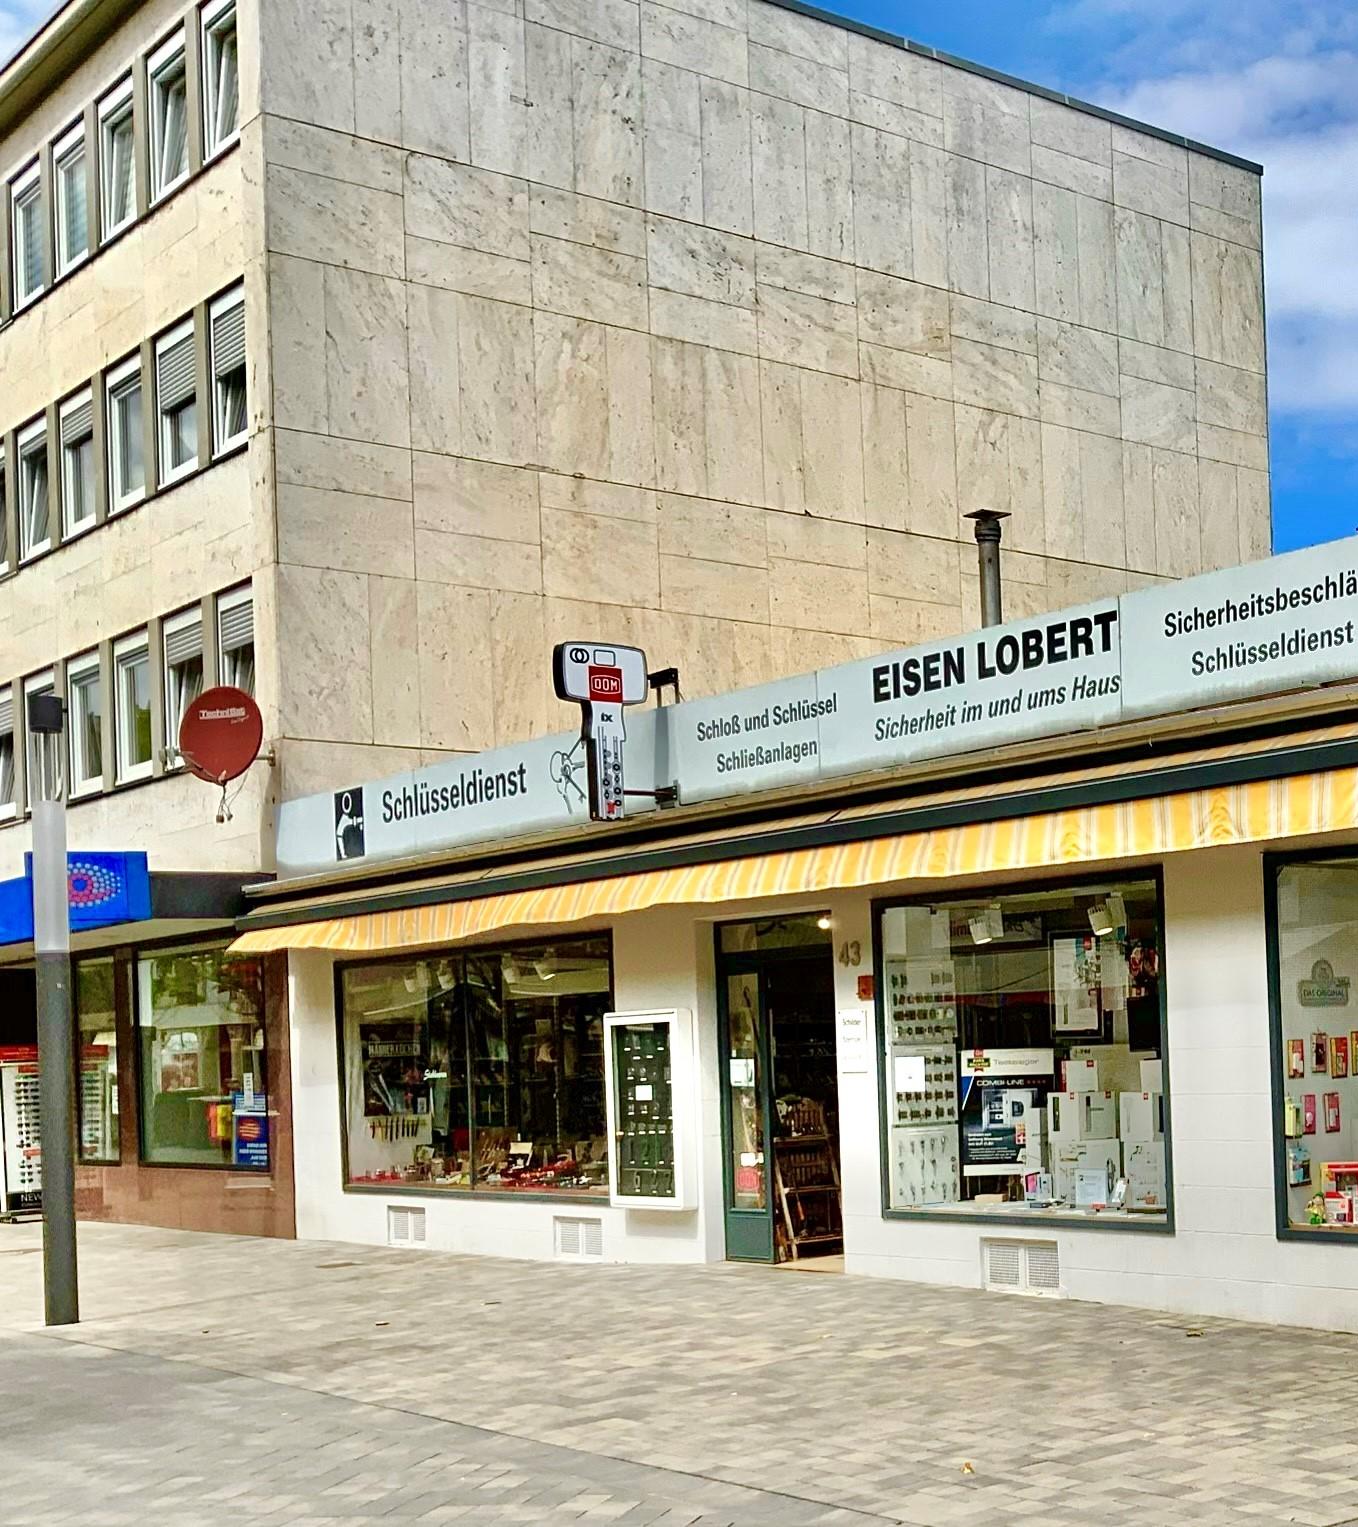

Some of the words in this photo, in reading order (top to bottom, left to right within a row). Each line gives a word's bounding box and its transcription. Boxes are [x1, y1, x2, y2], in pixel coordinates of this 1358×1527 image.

[872, 647, 965, 703] EISEN
[977, 610, 1118, 680] LOBERT
[1191, 620, 1354, 676] Schlüsseldienst
[594, 678, 618, 691] DOM
[874, 703, 957, 741] Sicherheit
[961, 701, 983, 724] im
[988, 689, 1023, 718] und
[1028, 686, 1066, 711] ums
[1072, 674, 1121, 701] Haus
[696, 714, 741, 742] Schloß
[744, 708, 769, 732] und
[772, 692, 837, 726] Schlüssel
[716, 740, 818, 773] Schließanlagen
[382, 762, 527, 823] Schlüsseldienst
[839, 940, 861, 967] 43
